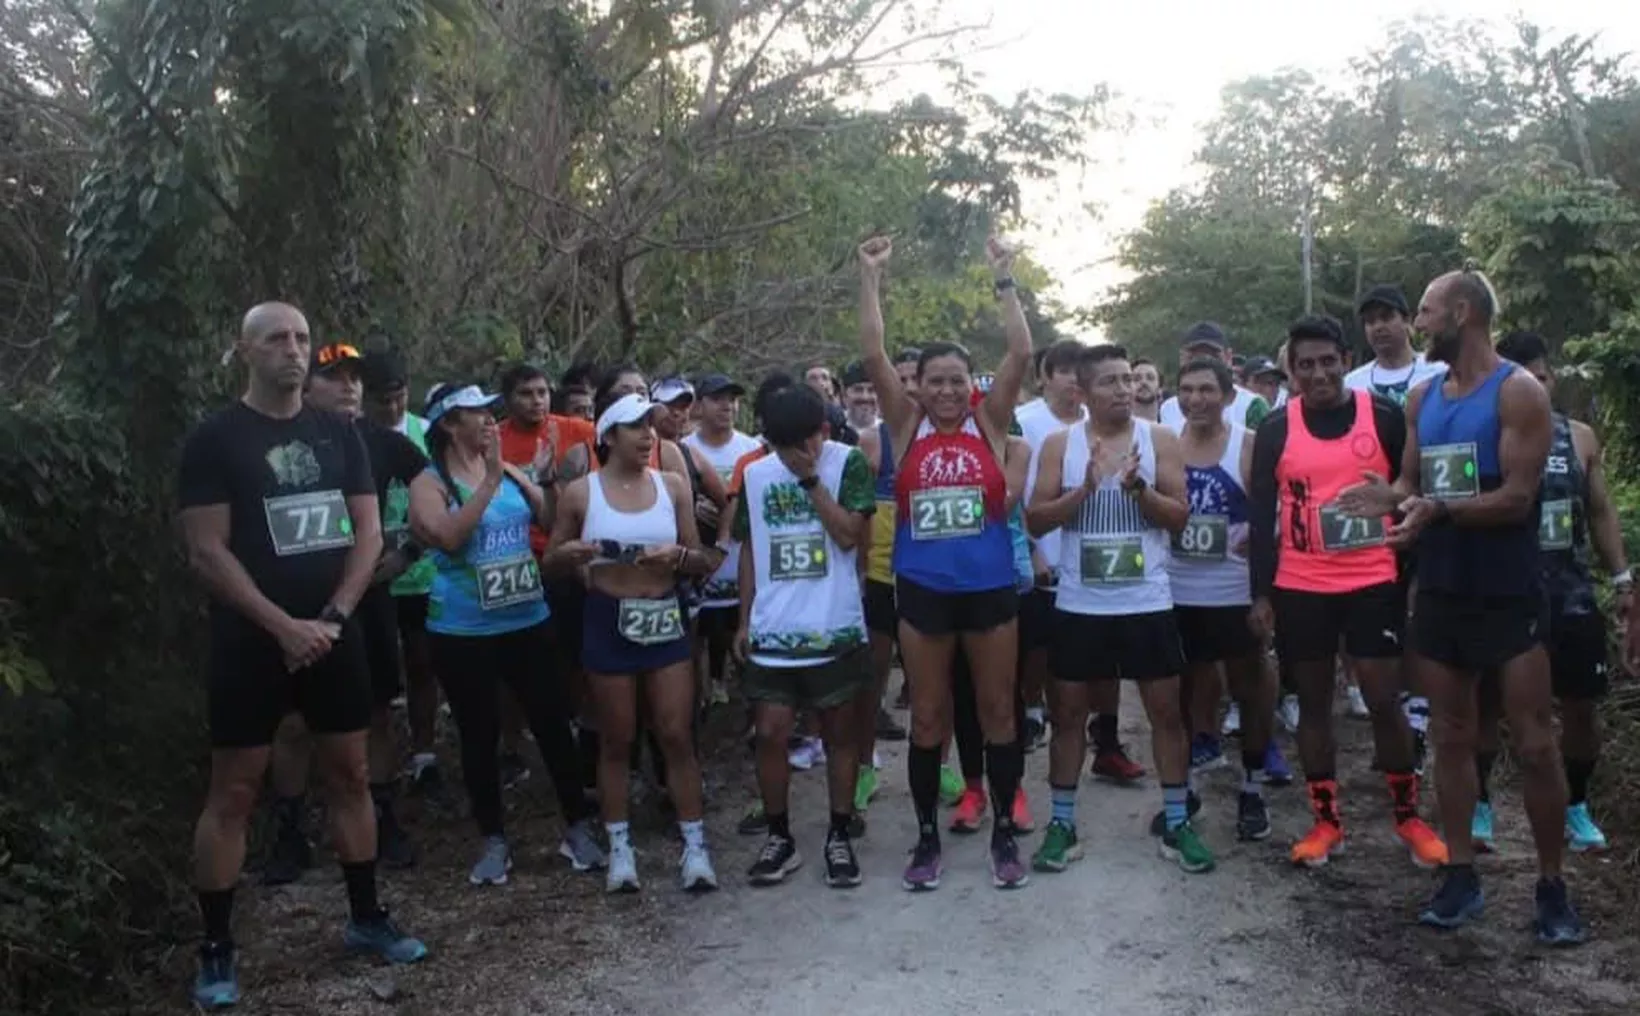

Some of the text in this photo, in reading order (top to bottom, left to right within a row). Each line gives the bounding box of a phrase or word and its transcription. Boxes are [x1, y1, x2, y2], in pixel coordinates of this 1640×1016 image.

[1434, 459, 1451, 488] 2
[287, 505, 330, 540] 77
[919, 499, 974, 529] 213
[1334, 514, 1369, 540] 71
[1181, 525, 1213, 551] 80
[780, 543, 810, 571] 55
[1101, 549, 1121, 574] 7
[487, 563, 535, 597] 214
[625, 610, 676, 636] 215
